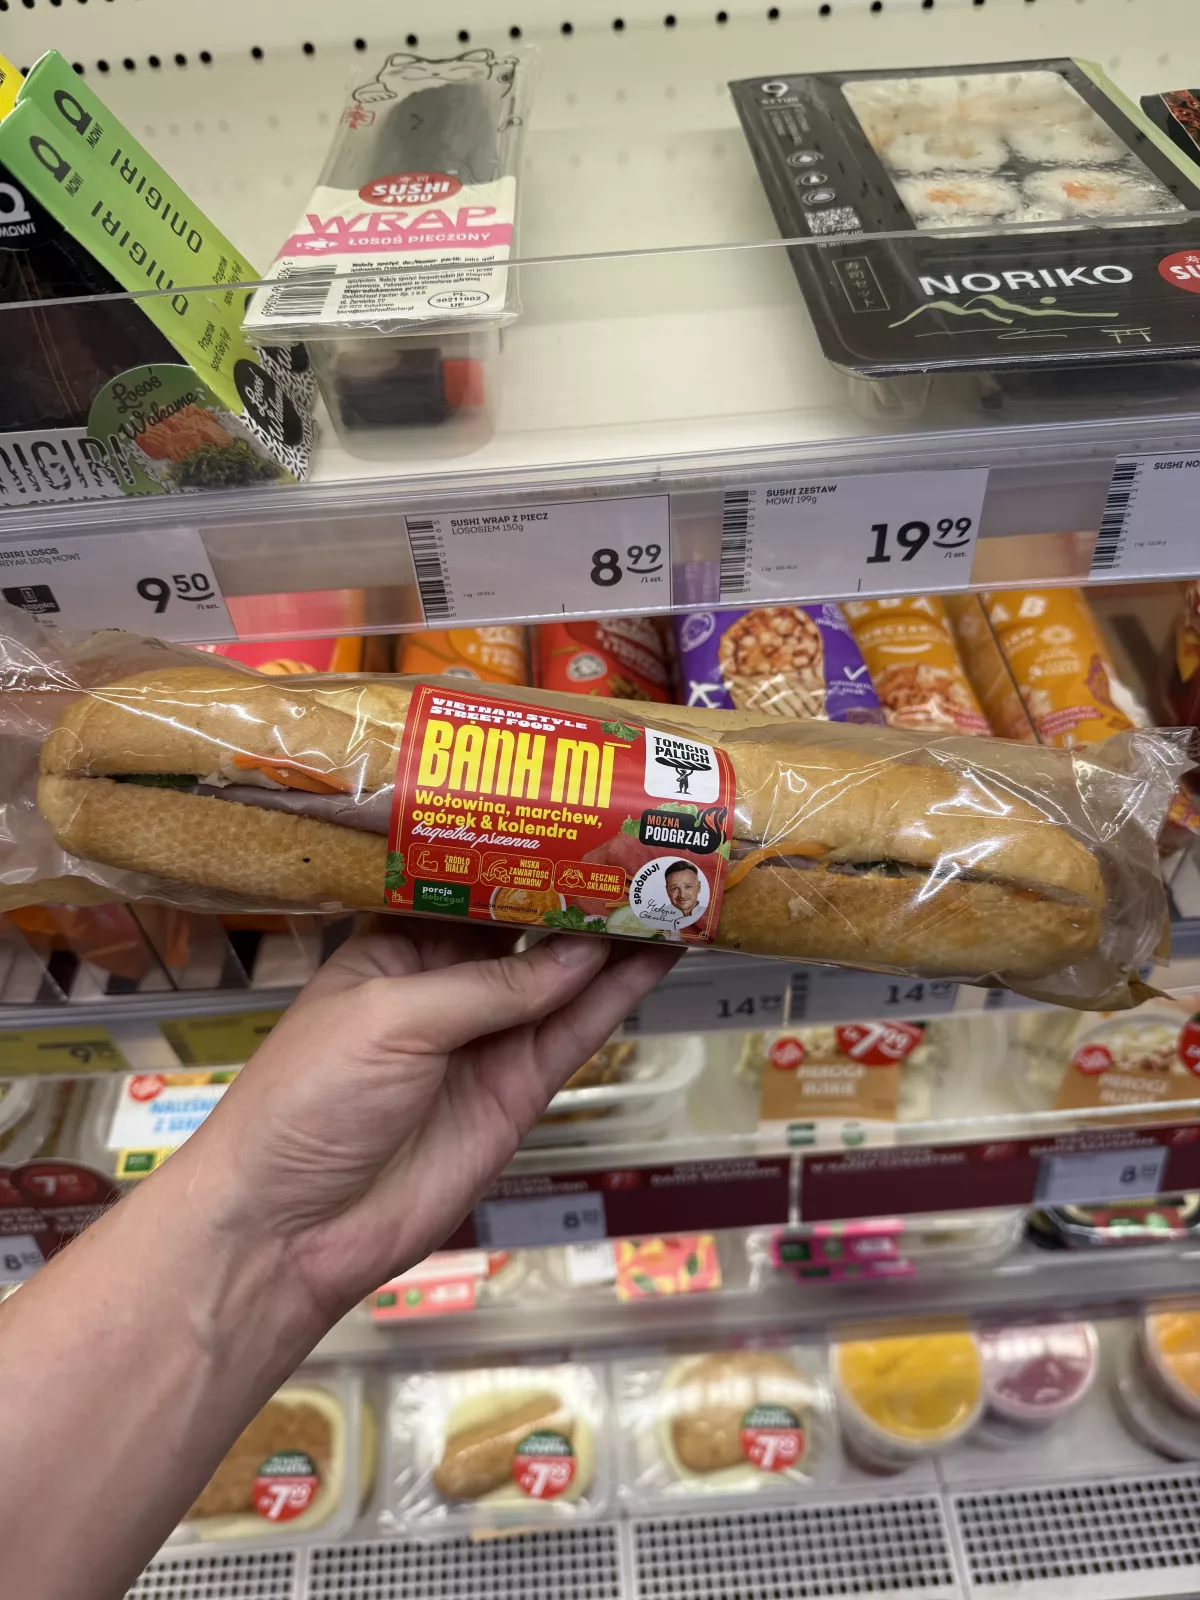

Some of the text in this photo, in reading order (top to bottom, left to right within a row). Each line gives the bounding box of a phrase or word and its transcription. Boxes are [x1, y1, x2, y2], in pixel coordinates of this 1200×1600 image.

[86, 122, 104, 148] MOWI
[372, 182, 450, 196] SUSHI
[383, 193, 433, 204] 4YOU
[110, 148, 203, 253] ONIGIRI
[306, 206, 496, 232] WRAP
[348, 232, 491, 246] ŁOSOŚ PIECZONY
[918, 265, 1134, 296] NORIKO
[1154, 461, 1184, 470] SUSHI
[765, 495, 817, 506] MOWI 199g
[766, 485, 837, 497] SUSHI ZESTAW
[450, 512, 549, 527] SUSHI WRAP Z PIECZ
[451, 523, 524, 535] LOSOSIEM 150g
[866, 517, 972, 564] 19 99
[27, 547, 59, 556] LOSOS
[28, 556, 53, 566] 100g
[53, 553, 81, 562] MOWI
[590, 544, 662, 587] 8 99
[137, 573, 210, 614] 9 50
[430, 706, 556, 732] STREET FOOD
[432, 697, 588, 730] VIETNAM STYLE
[653, 736, 709, 756] TOMCIO
[655, 746, 710, 764] PALUCH
[415, 789, 603, 829] Wołowina, marchew,
[412, 808, 579, 841] ogórek & kolendra
[647, 815, 680, 829] MOŻNA
[411, 820, 541, 850] bagietka pszenna
[645, 825, 710, 847] PODGRZAĆ
[520, 859, 540, 869] NISKA
[586, 881, 621, 893] SKŁADANE
[590, 872, 620, 884] RĘCZNIE
[421, 892, 465, 905] dobrego!
[422, 885, 453, 897] porcja
[884, 983, 925, 1004] 14
[717, 998, 756, 1018] 14
[850, 1022, 885, 1057] 7
[756, 1435, 778, 1469] 7
[528, 1462, 550, 1498] 7
[268, 1484, 292, 1520] 7
